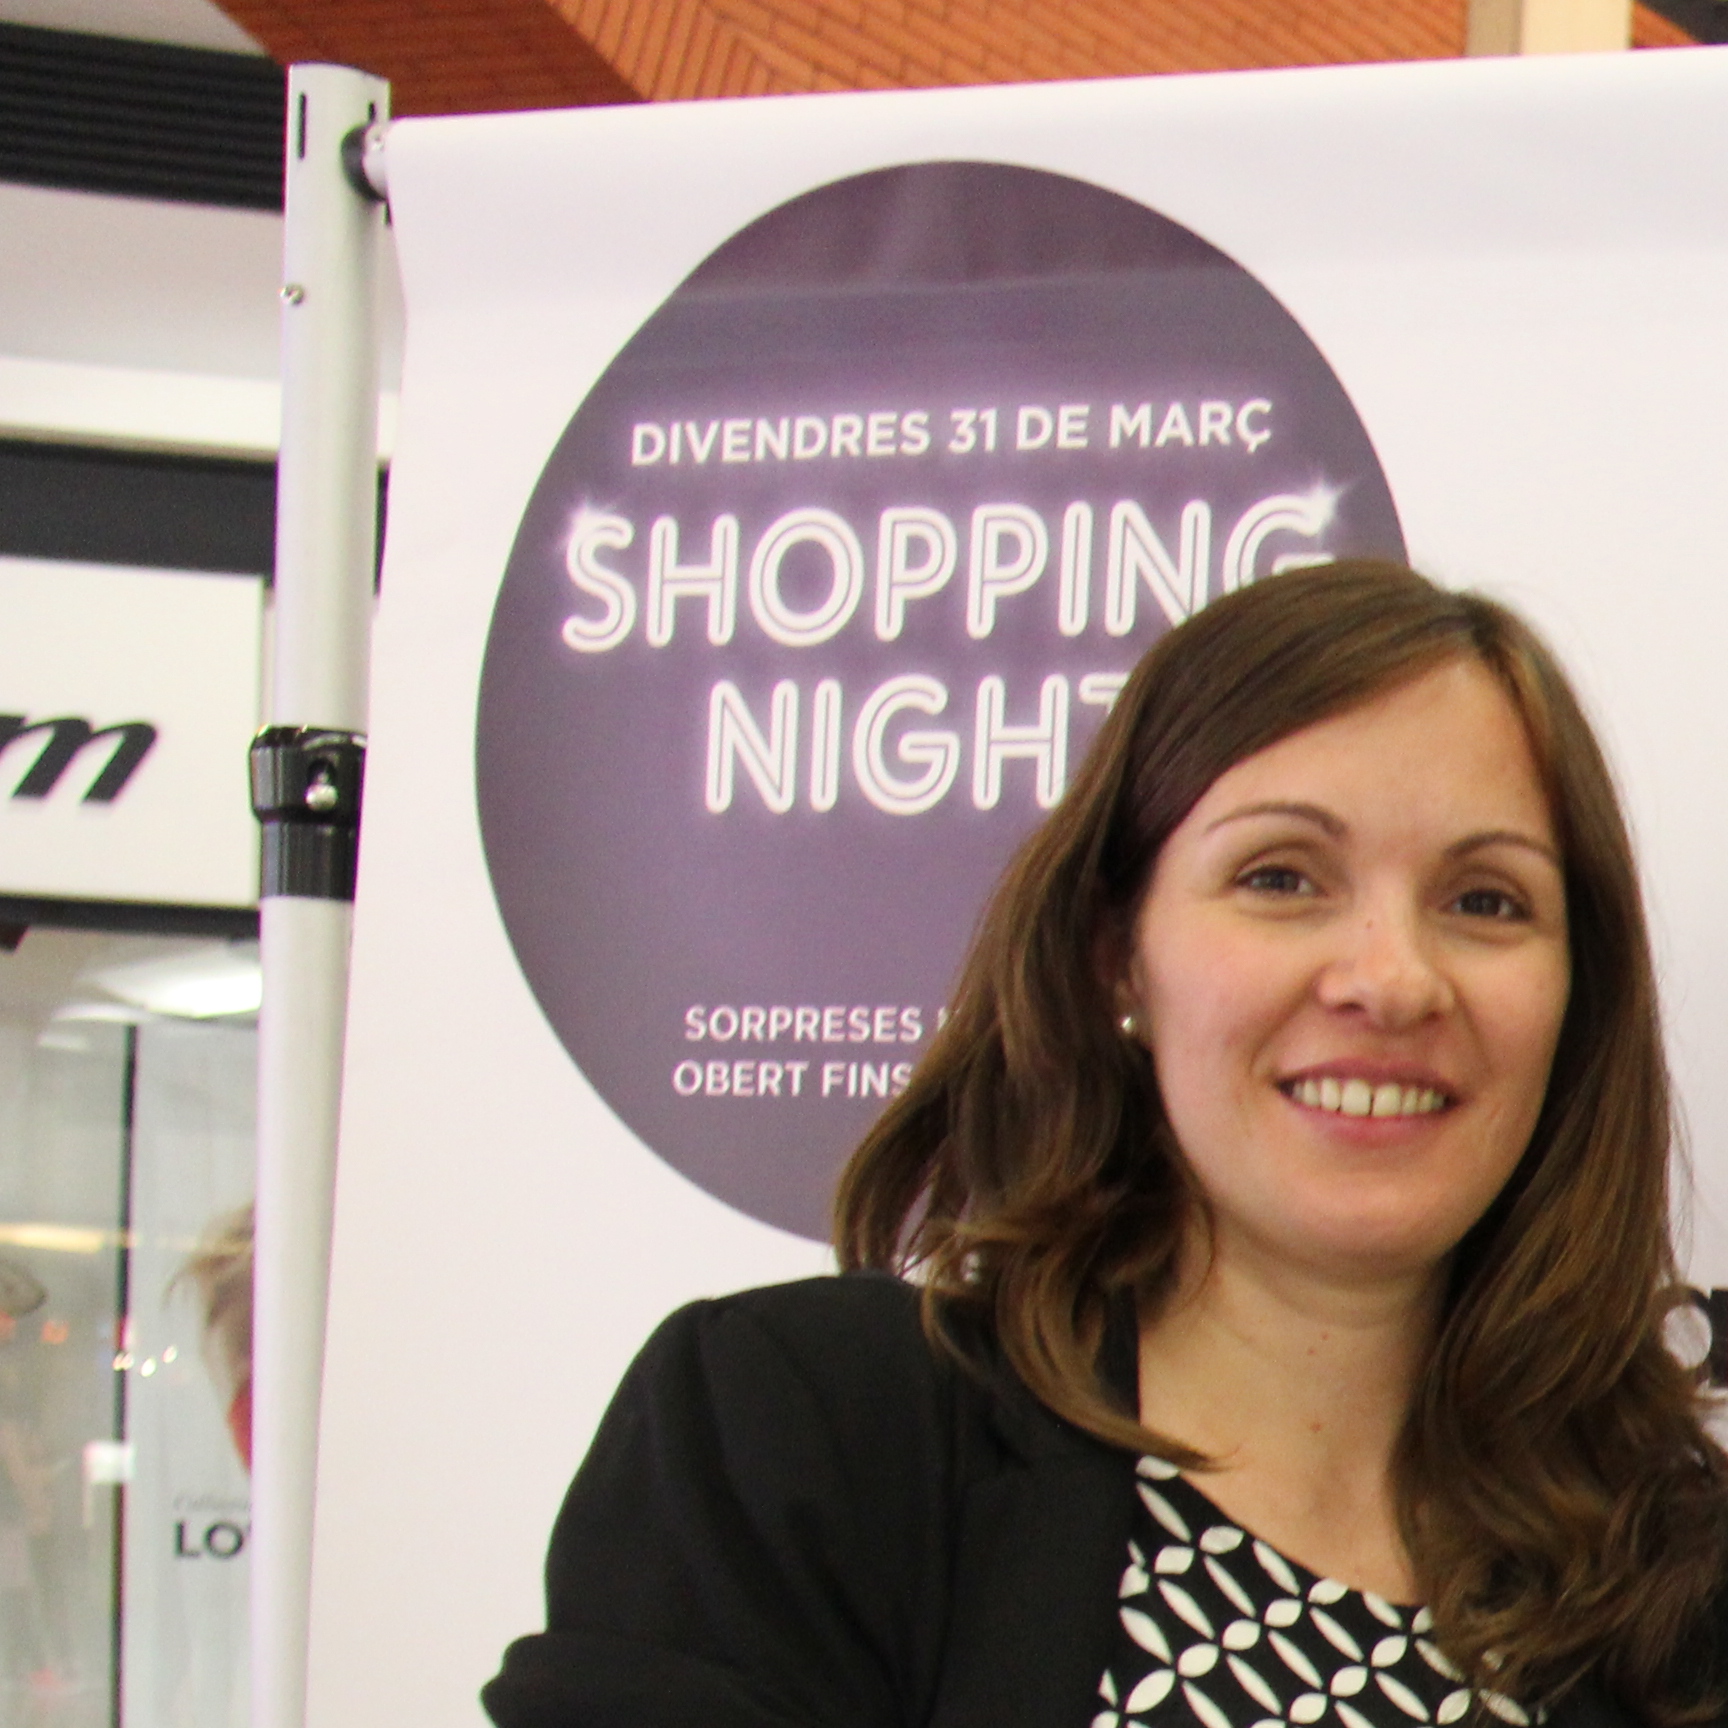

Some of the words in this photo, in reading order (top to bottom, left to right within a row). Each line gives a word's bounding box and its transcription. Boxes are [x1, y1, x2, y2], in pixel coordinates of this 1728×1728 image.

[632, 411, 930, 466] DIVENDRES
[949, 408, 997, 455] 31
[1016, 405, 1091, 452] DE
[1108, 399, 1274, 455] MARÇ
[561, 493, 1338, 652] SHOPPING
[684, 1004, 924, 1043] SORPRESES
[672, 1059, 810, 1098] OBERT
[821, 1061, 914, 1099] FINS
[173, 1519, 250, 1559] LO
